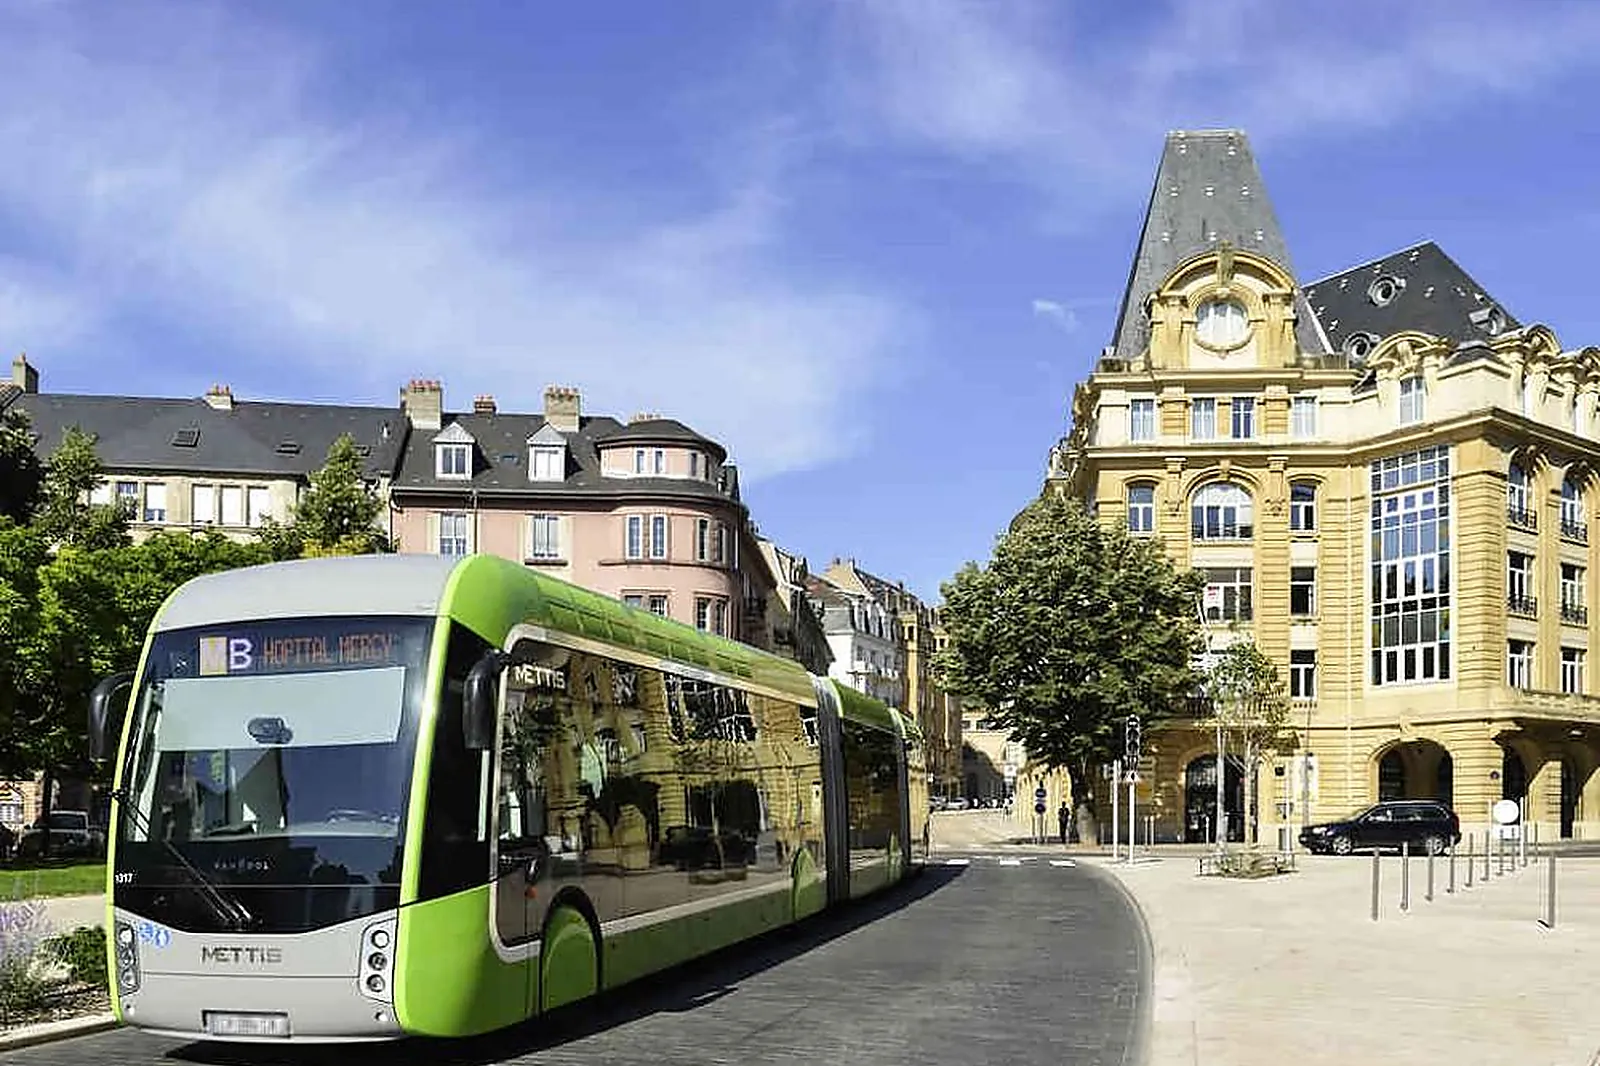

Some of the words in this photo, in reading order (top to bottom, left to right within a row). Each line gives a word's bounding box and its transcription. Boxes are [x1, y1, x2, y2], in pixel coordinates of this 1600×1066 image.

[229, 638, 252, 669] B
[338, 633, 392, 662] MERCY
[513, 664, 566, 689] METTIS
